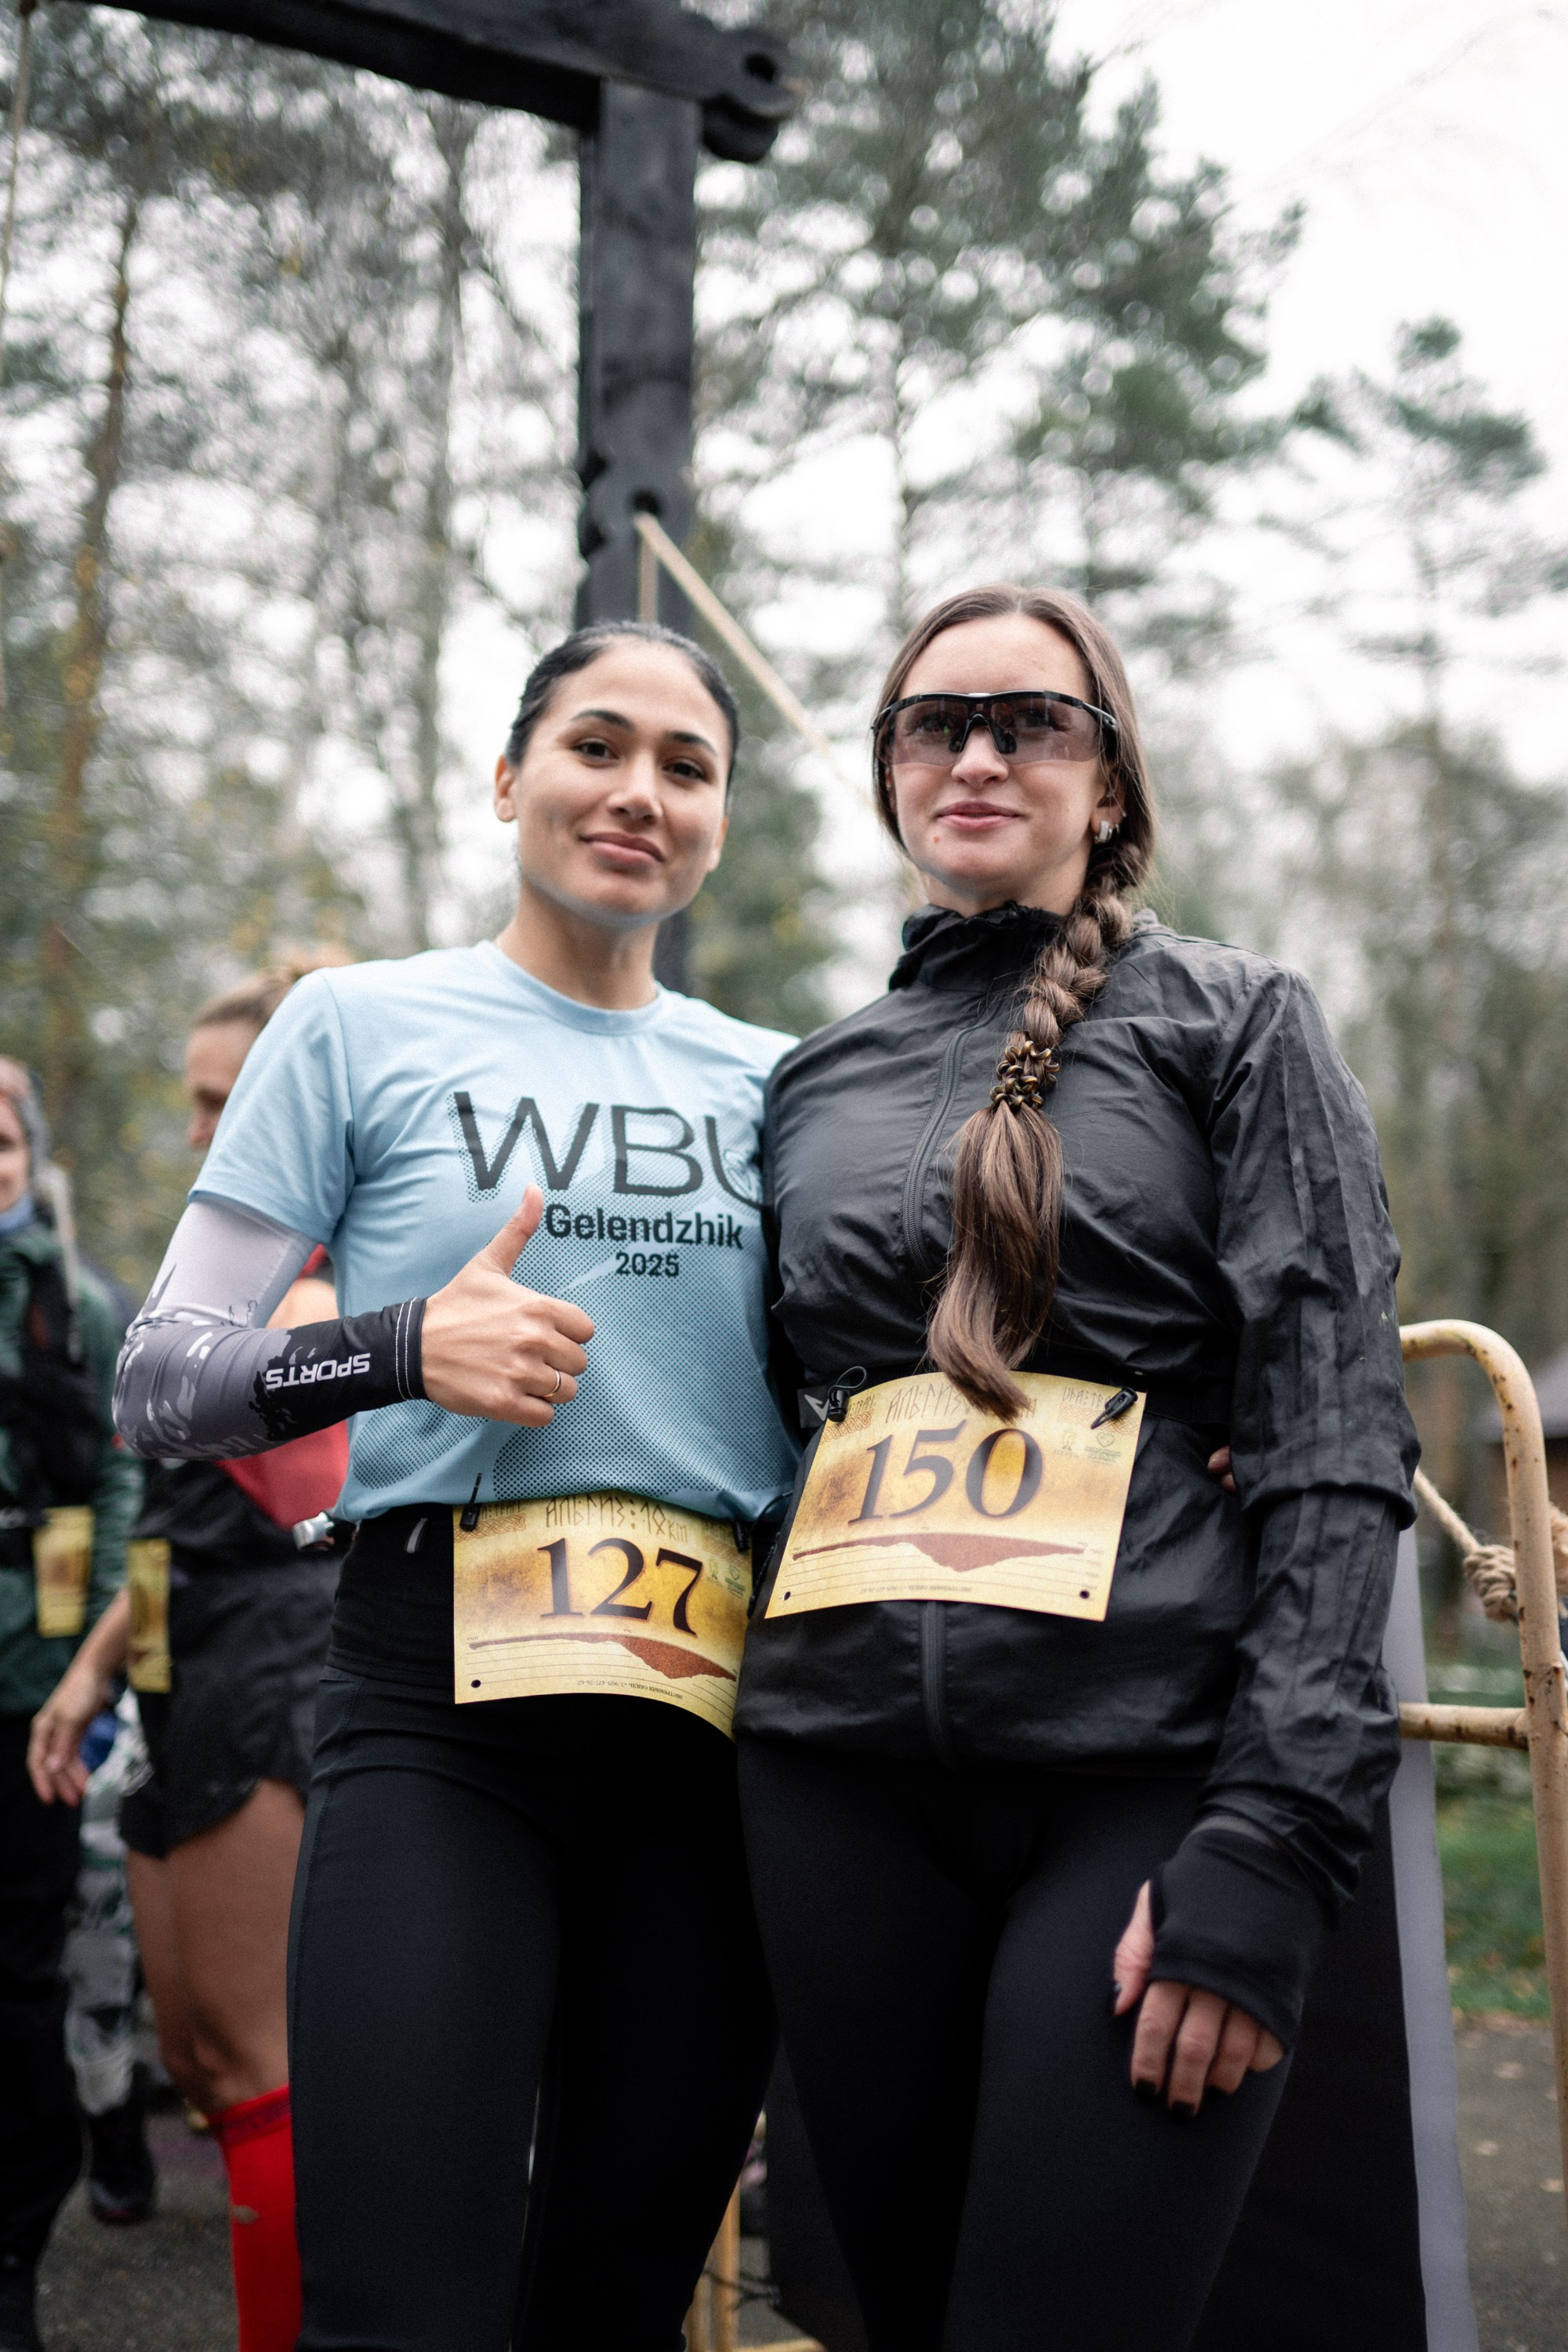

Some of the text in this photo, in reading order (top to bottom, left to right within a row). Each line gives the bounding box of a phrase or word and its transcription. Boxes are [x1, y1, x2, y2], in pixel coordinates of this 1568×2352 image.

[546, 1203, 744, 1250] Gelendzhik
[615, 1252, 680, 1277] 2025
[265, 1352, 371, 1390] SPORTS
[848, 1419, 1043, 1526] 150
[536, 1537, 703, 1637] 127
